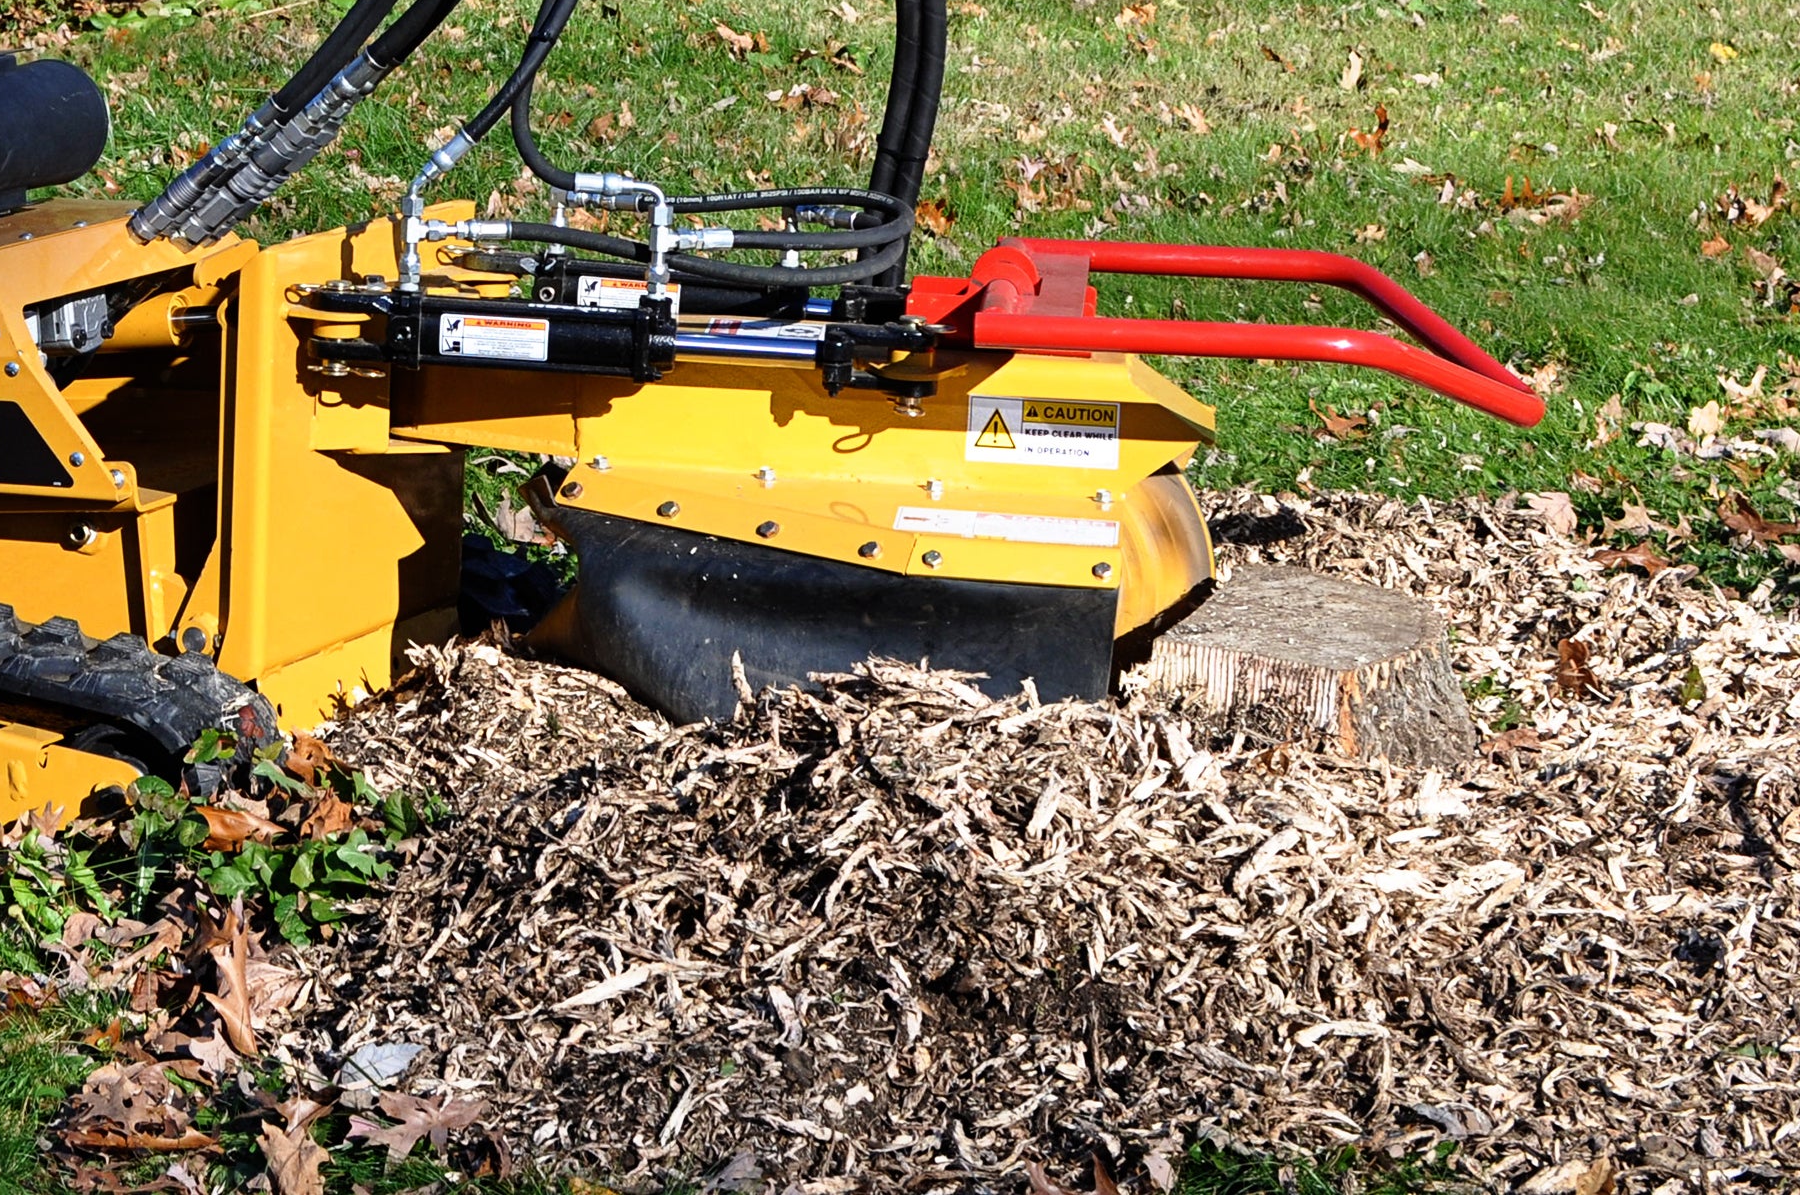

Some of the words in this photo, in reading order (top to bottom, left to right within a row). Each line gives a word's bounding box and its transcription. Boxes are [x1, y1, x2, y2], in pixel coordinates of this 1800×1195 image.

[484, 319, 532, 328] WARNING
[1043, 406, 1114, 422] CAUTION
[1025, 428, 1049, 436] KEEP
[1051, 430, 1082, 439] CLEAR
[1084, 432, 1114, 441] WHILE
[1037, 447, 1090, 457] OPERATION
